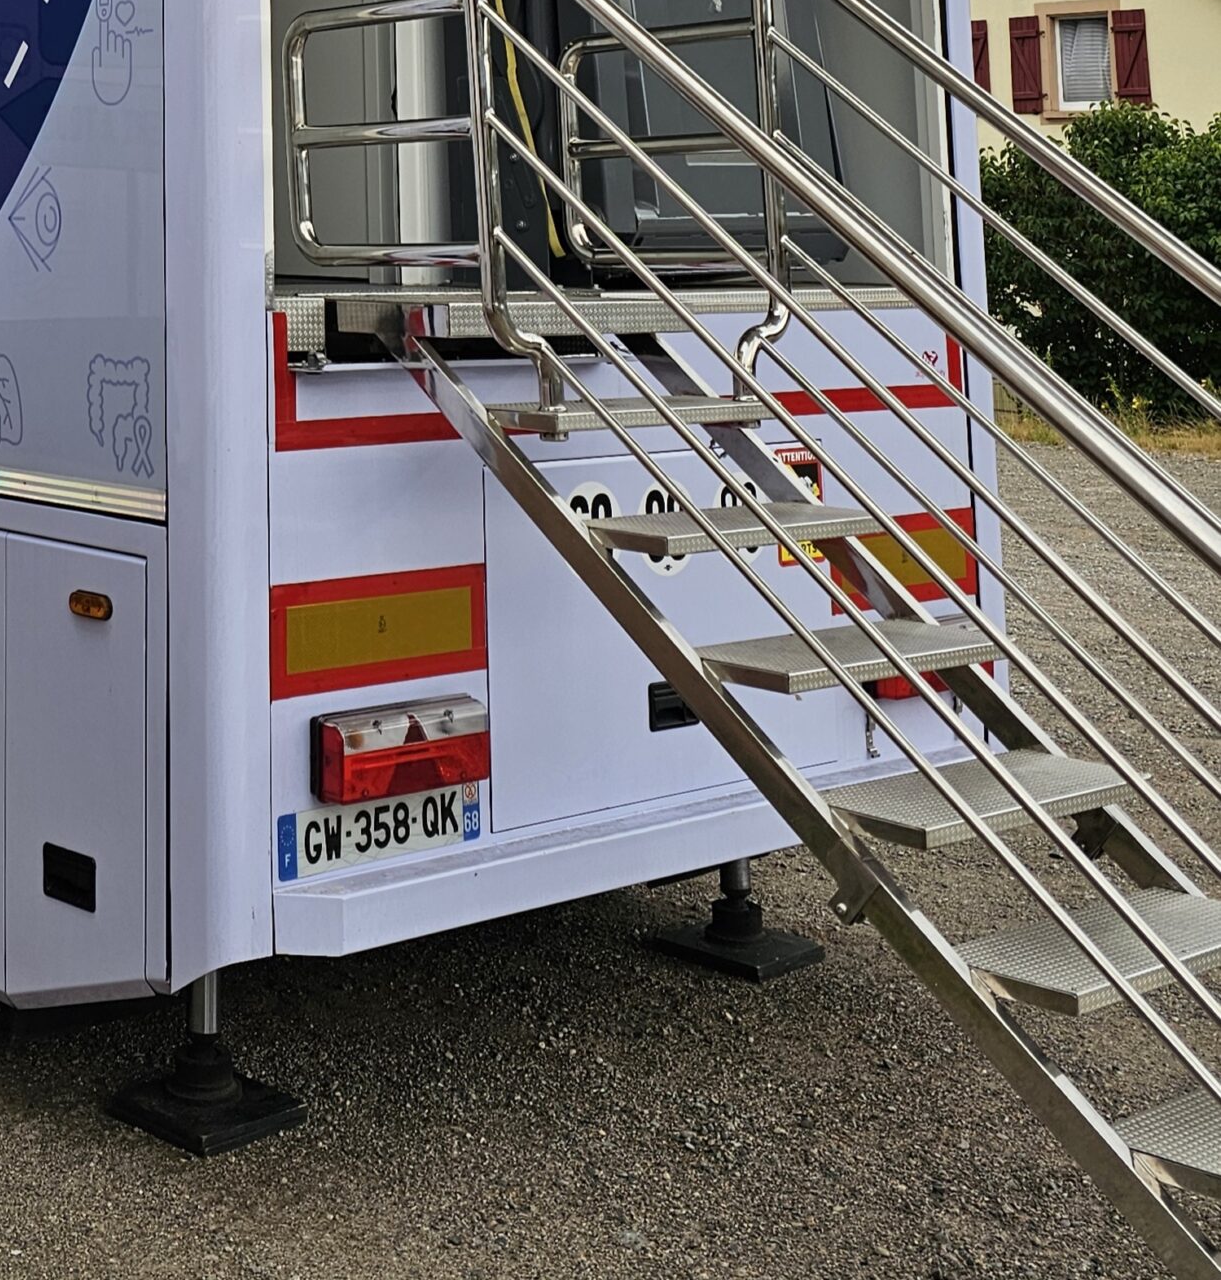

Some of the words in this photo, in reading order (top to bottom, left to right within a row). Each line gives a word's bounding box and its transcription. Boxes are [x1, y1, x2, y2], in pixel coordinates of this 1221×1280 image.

[304, 790, 459, 865] GW-358-QK
[464, 810, 478, 833] 68
[285, 853, 291, 868] F
